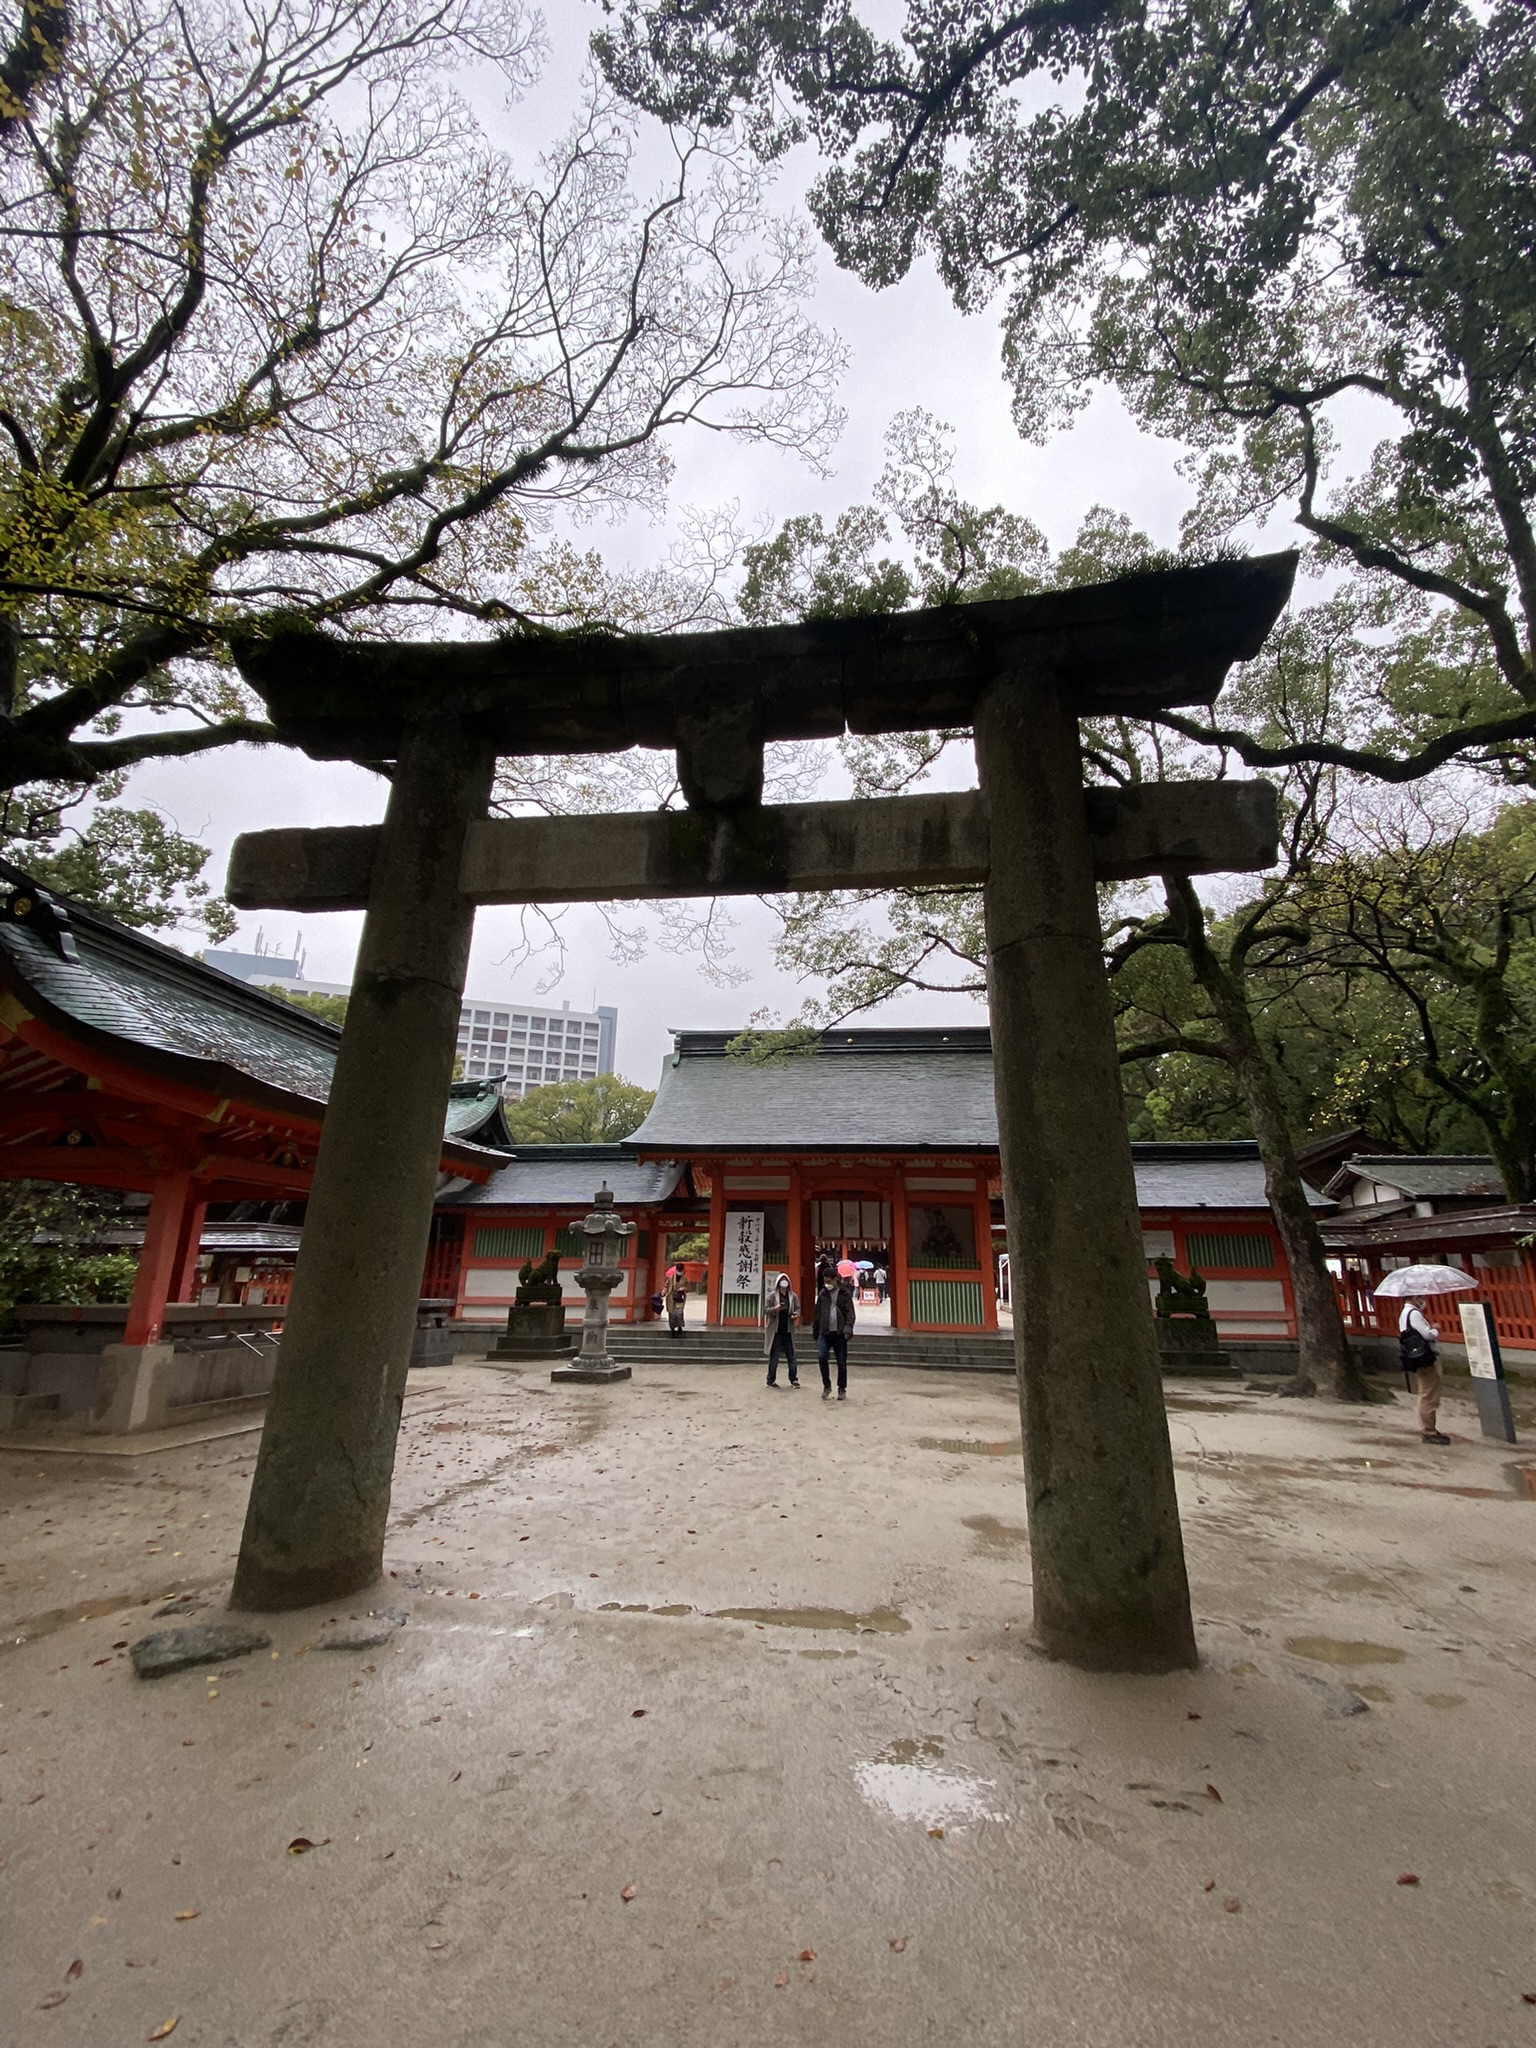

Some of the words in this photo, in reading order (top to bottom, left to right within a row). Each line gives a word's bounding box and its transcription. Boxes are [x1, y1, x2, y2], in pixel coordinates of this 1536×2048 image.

[736, 1215, 754, 1290] 新穀感謝祭
